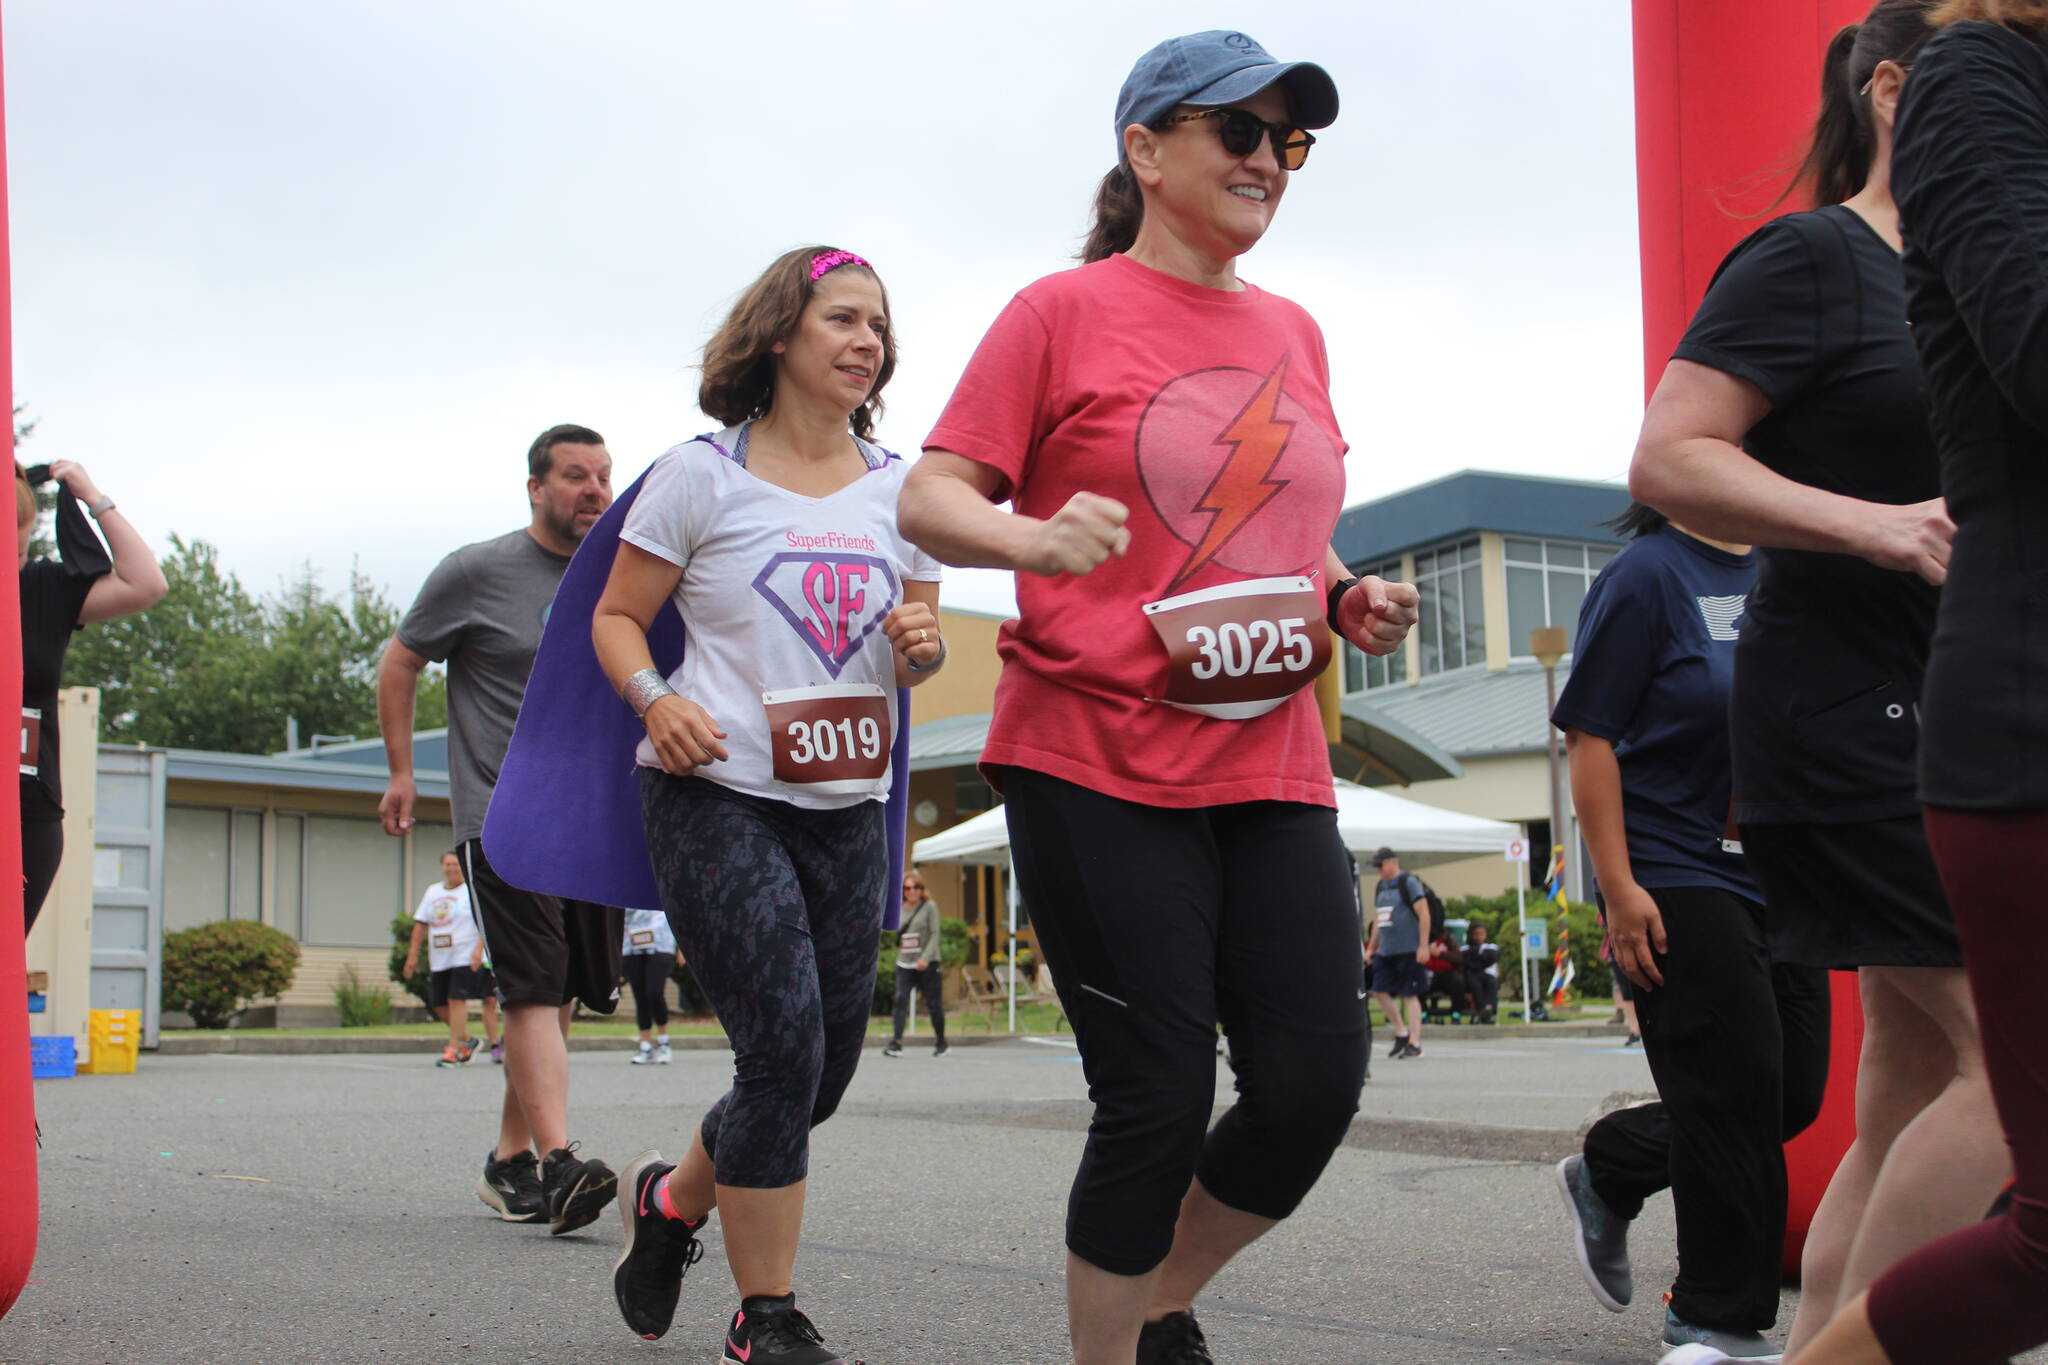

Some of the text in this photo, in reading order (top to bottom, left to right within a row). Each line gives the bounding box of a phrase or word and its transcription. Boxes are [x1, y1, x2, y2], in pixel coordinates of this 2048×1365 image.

[787, 531, 875, 551] SuperFriends
[802, 562, 869, 658] SF
[1186, 618, 1312, 679] 3025
[788, 717, 880, 764] 3019
